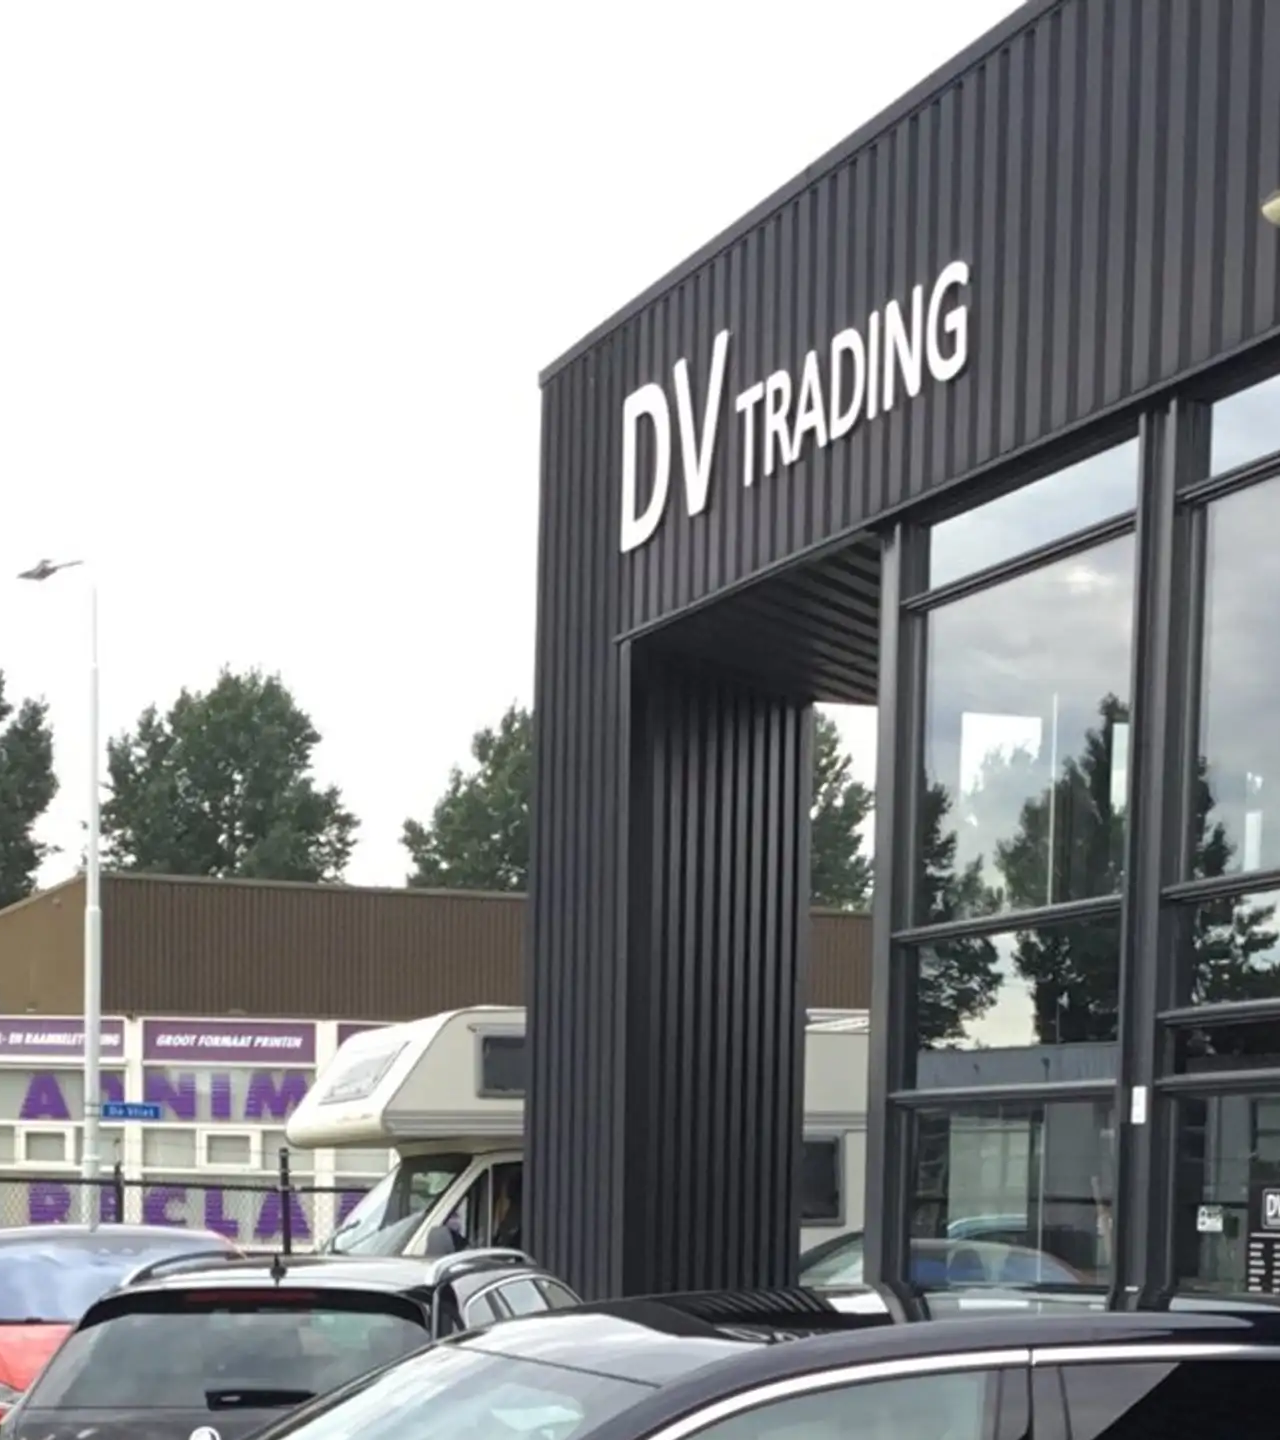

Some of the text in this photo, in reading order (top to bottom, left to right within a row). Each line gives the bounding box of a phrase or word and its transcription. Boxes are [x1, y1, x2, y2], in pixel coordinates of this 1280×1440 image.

[620, 259, 970, 553] DV TRADING
[156, 1033, 303, 1049] GROOT FORMAAT PRINTEN
